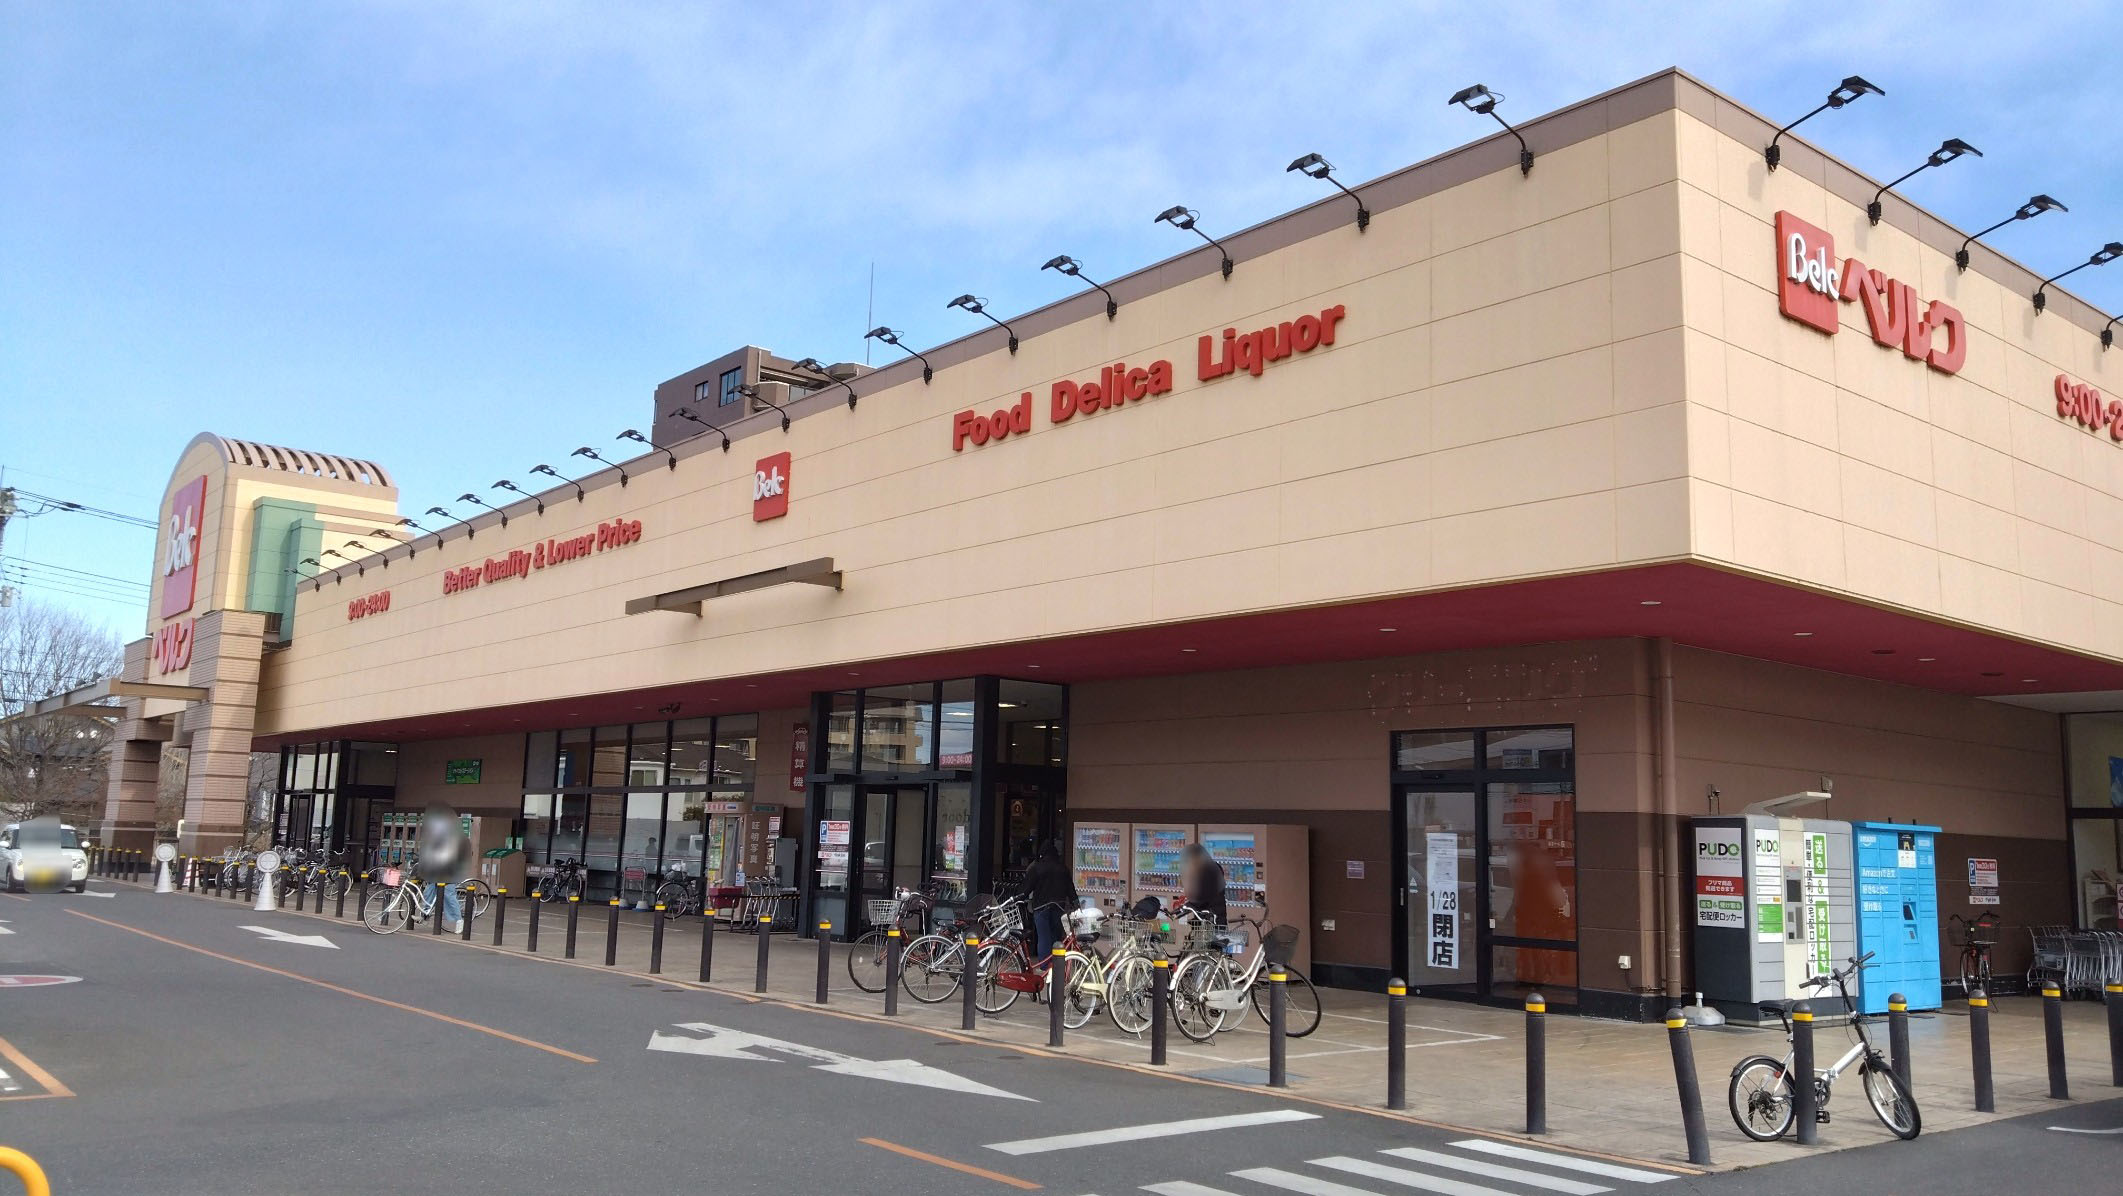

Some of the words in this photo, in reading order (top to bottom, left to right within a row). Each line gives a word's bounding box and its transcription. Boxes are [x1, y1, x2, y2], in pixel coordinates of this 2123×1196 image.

[1787, 233, 1839, 300] Belc
[1839, 258, 1966, 374] ベルク
[953, 392, 1032, 451] Food
[1051, 359, 1173, 423] Delica
[1198, 304, 1345, 381] Liquor
[754, 466, 785, 500] Belc
[443, 566, 482, 594] Better
[483, 551, 532, 583] Quality
[533, 543, 545, 569] &
[547, 533, 595, 565] Lower
[597, 518, 641, 551] Price
[153, 618, 195, 674] ベルク
[1699, 843, 1740, 856] PUDO
[1756, 839, 1779, 852] PUDO
[1430, 891, 1457, 911] 1/28
[1699, 911, 1743, 921] 宅配便ロッカー
[1432, 913, 1454, 967] 閉店
